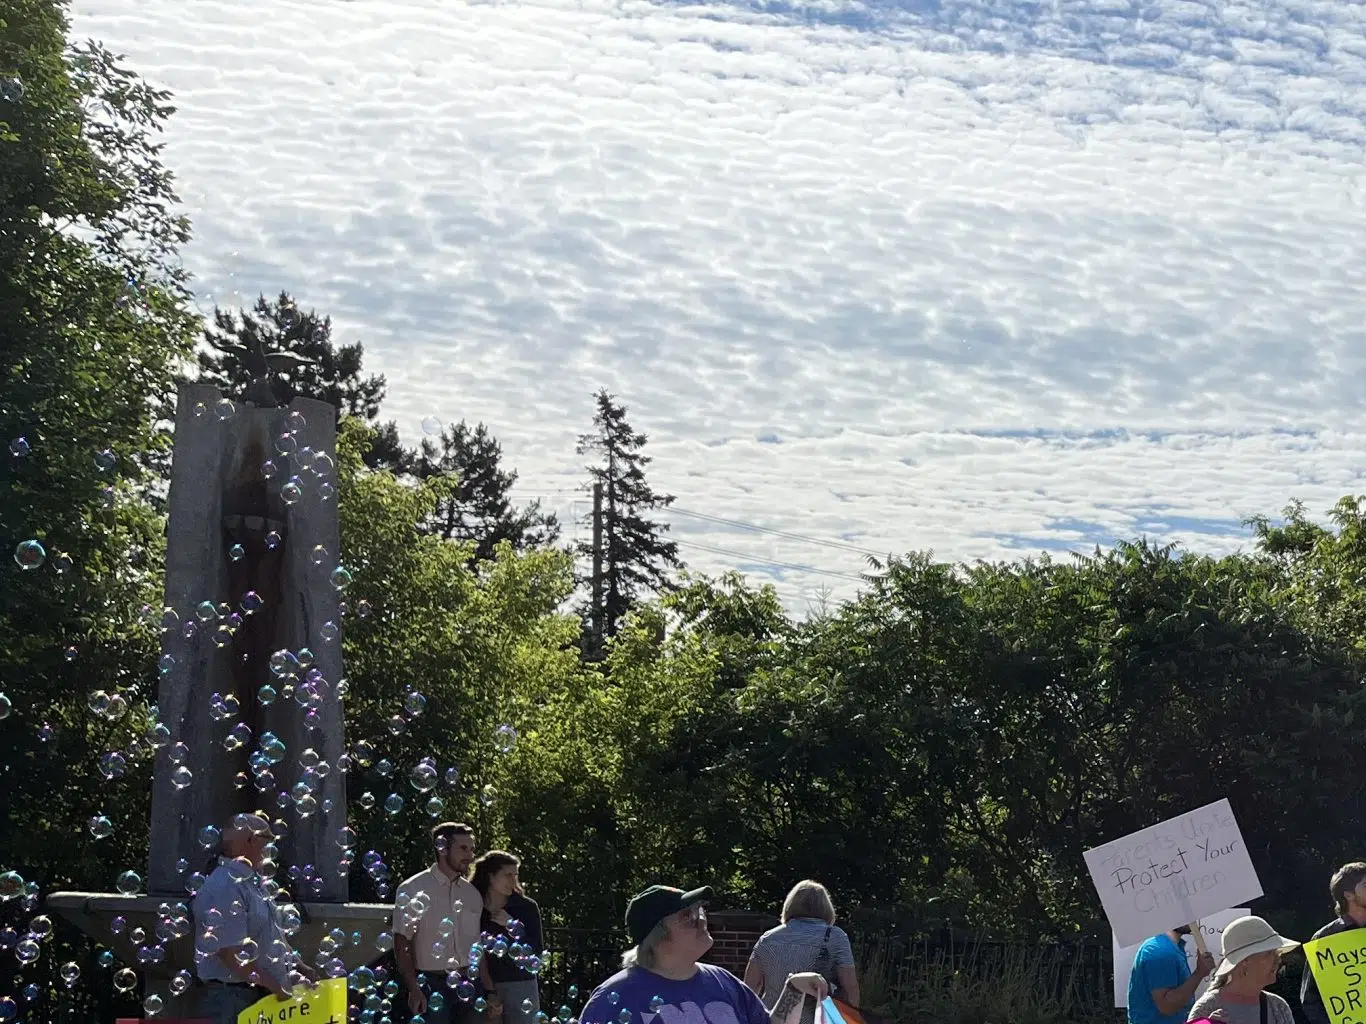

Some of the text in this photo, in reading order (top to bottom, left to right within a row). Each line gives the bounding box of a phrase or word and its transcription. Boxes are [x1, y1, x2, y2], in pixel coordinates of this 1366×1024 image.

[1101, 833, 1176, 867] Parents
[1110, 838, 1239, 894] Protect Your
[1134, 870, 1228, 913] Children
[279, 1002, 310, 1021] are
